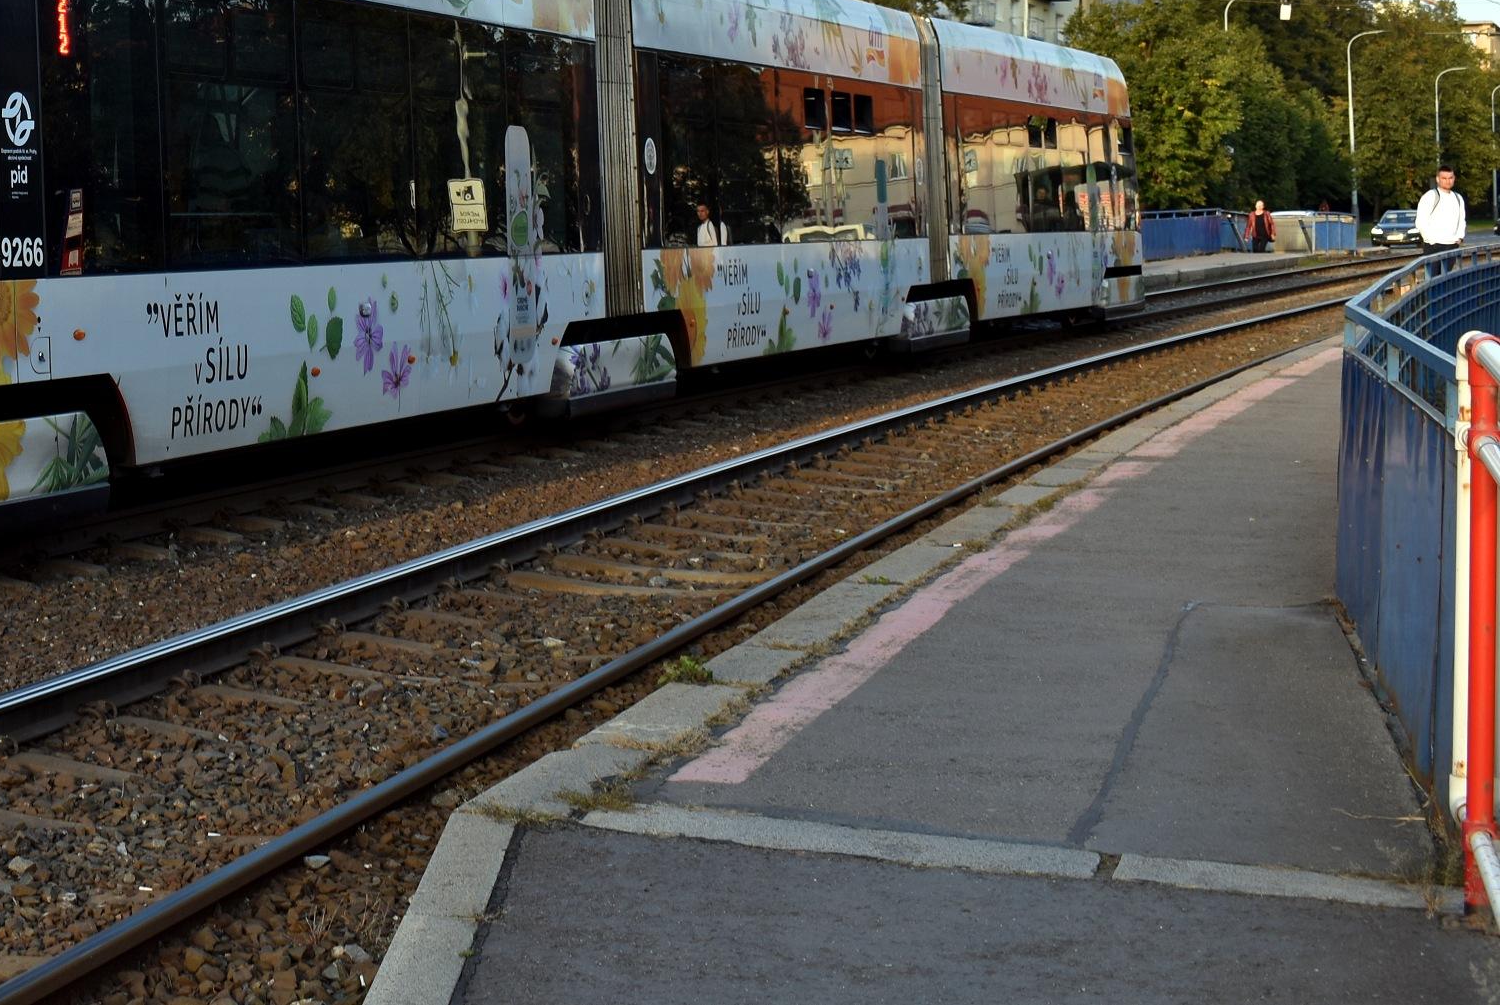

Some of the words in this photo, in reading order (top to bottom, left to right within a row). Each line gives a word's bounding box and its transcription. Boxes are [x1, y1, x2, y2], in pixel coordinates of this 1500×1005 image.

[10, 164, 28, 188] pid
[1, 237, 44, 267] 9266
[741, 286, 761, 316] SÍLU
[195, 362, 203, 385] v
[205, 336, 248, 384] SÍLU
